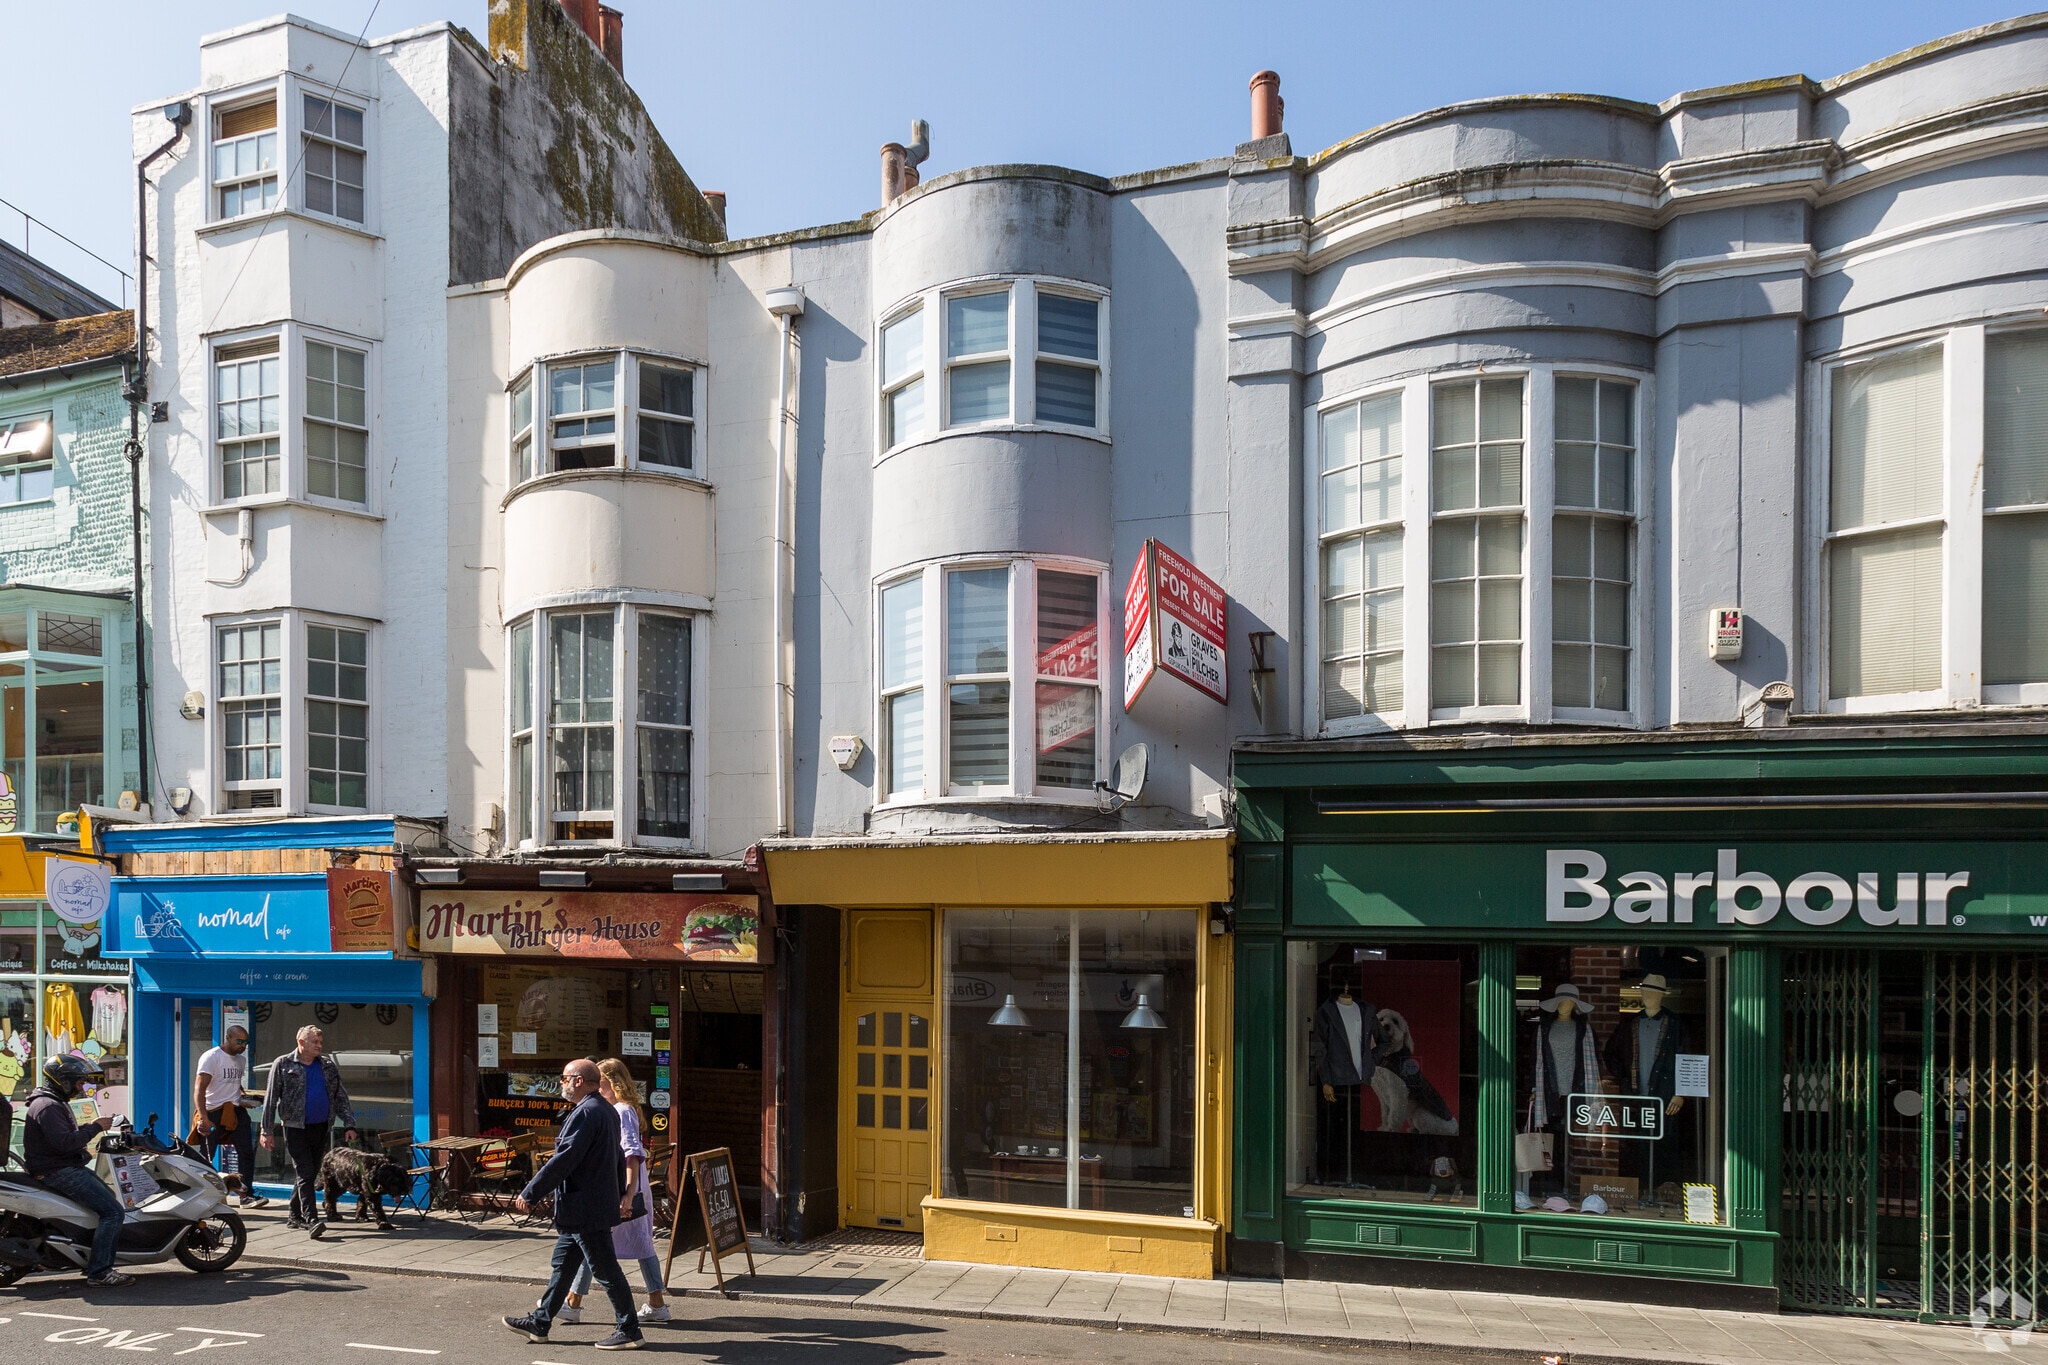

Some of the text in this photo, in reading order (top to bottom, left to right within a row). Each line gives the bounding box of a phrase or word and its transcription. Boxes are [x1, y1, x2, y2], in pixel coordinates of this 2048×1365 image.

[1158, 548, 1190, 578] FREEHOLD
[1192, 572, 1223, 604] INVESTMENT
[1133, 572, 1147, 615] SALE
[1160, 566, 1190, 606] FOR
[1193, 590, 1224, 631] SALE
[1162, 596, 1180, 612] PRESENT
[1191, 632, 1218, 662] GRAVES
[1192, 648, 1200, 657] SON
[1192, 657, 1220, 685] PILCHER
[1545, 848, 1970, 926] Barbour
[64, 898, 93, 911] nomad
[198, 892, 270, 940] nomad
[276, 924, 292, 940] cafe
[504, 915, 662, 953] Burger House
[638, 938, 676, 949] Takeaway
[50, 958, 129, 972] Coffee Milkshakes
[239, 968, 262, 986] coffee
[284, 973, 310, 981] cream
[488, 1098, 525, 1110] BURGERS
[527, 1100, 550, 1110] 100%
[514, 1117, 551, 1127] CHICKEN
[1576, 1103, 1656, 1130] SALE
[1592, 1184, 1626, 1192] Barbour
